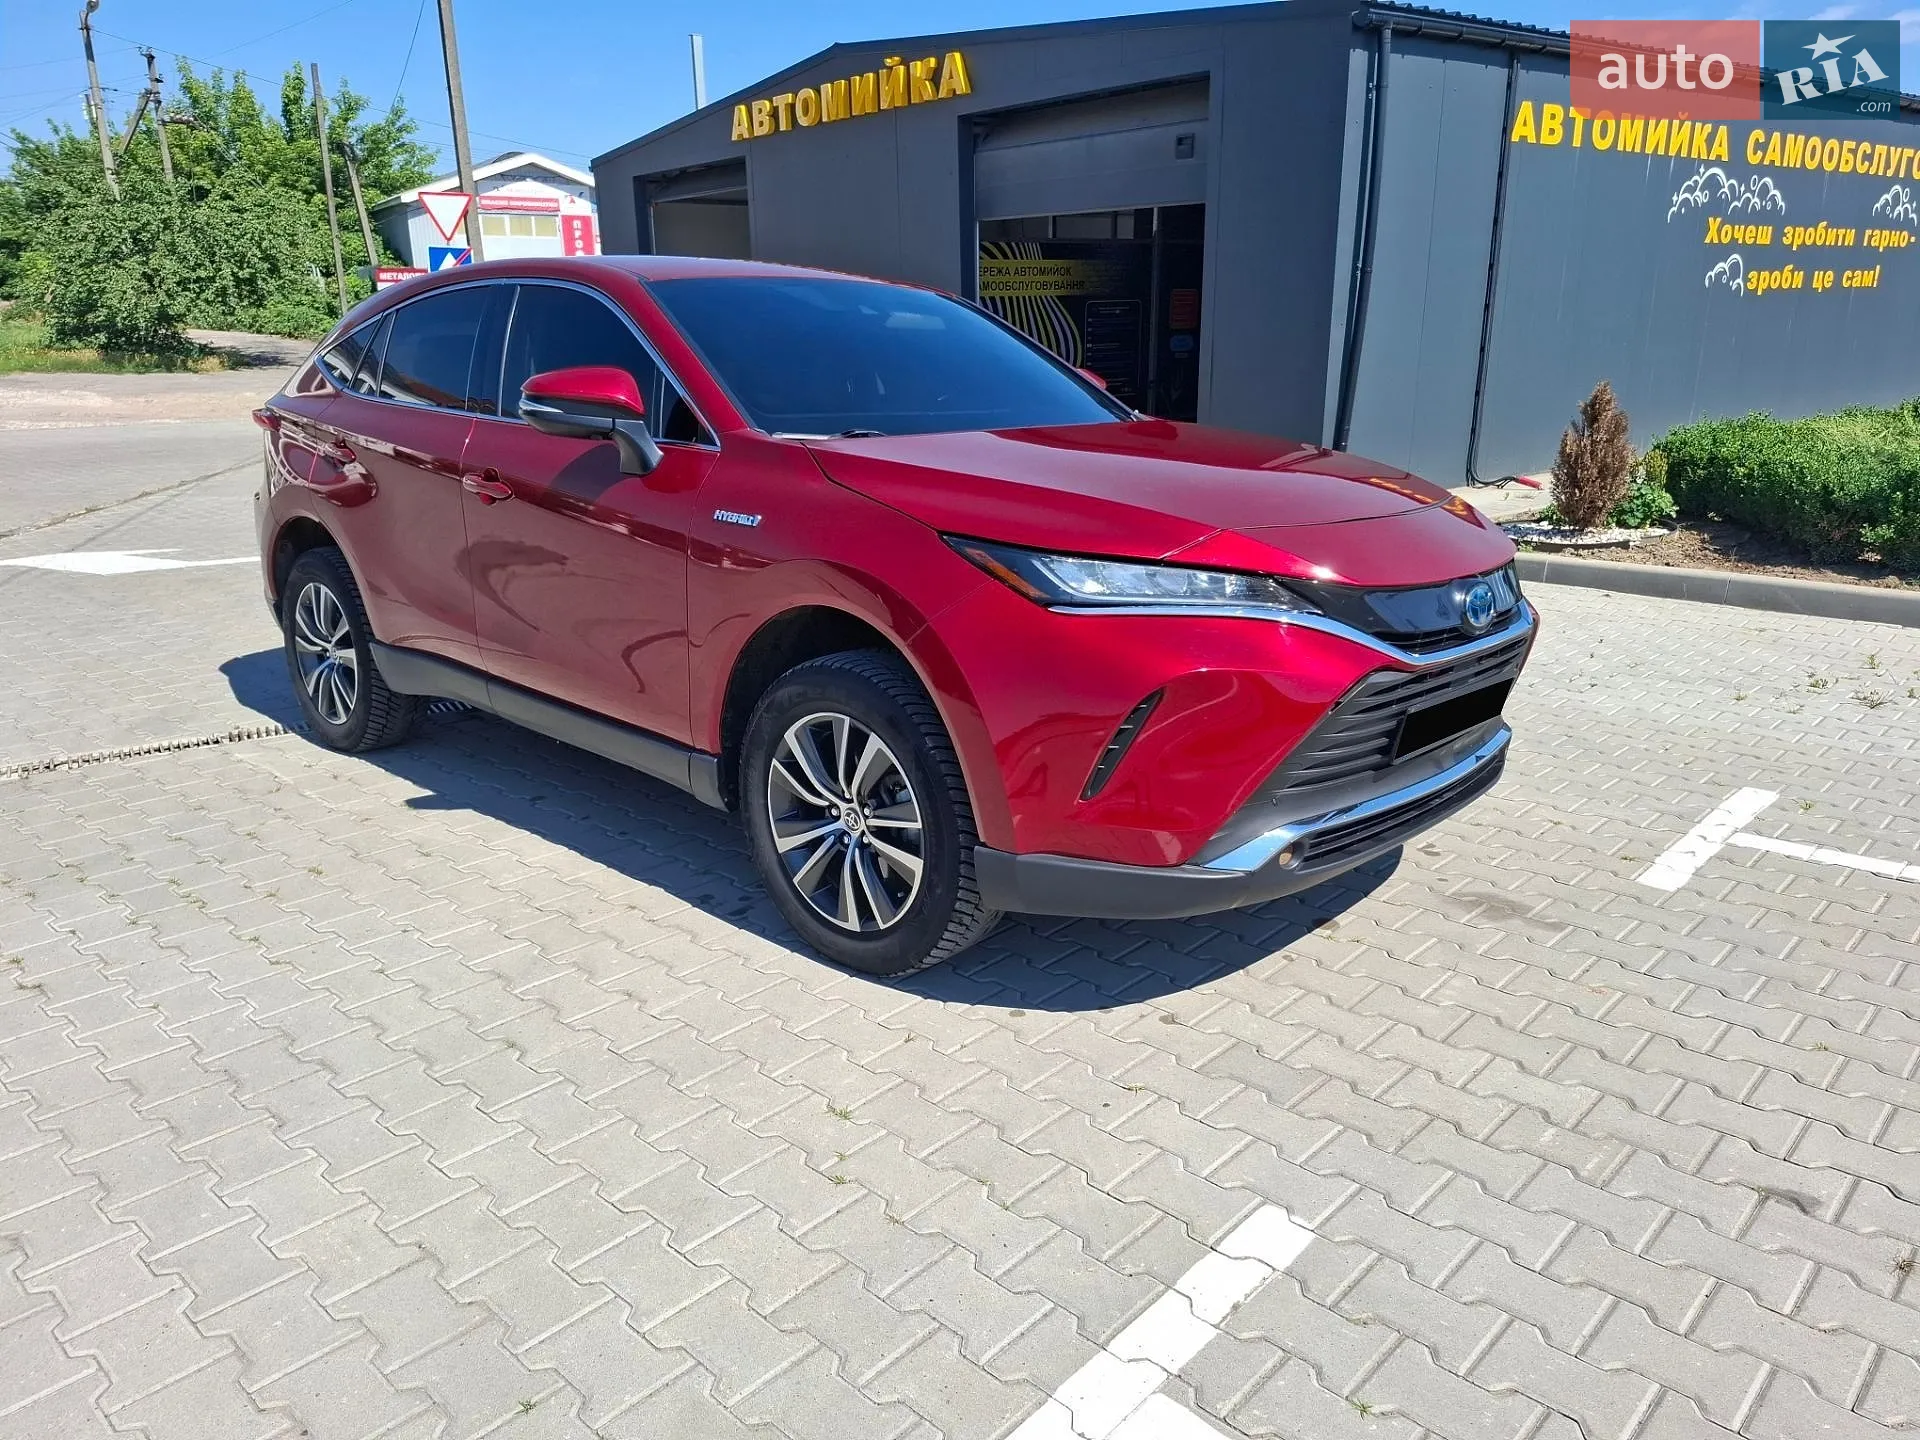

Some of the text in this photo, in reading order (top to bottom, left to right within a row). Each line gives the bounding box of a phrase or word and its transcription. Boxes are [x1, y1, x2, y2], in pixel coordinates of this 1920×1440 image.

[731, 50, 972, 141] АВТОМИЙКА
[1511, 100, 1729, 162] АВТОМИЙКА
[1704, 216, 1916, 252] Хочеш зробити гарно-
[1013, 263, 1072, 277] АВТОМИЙОК
[1746, 264, 1881, 296] зроби це сам!
